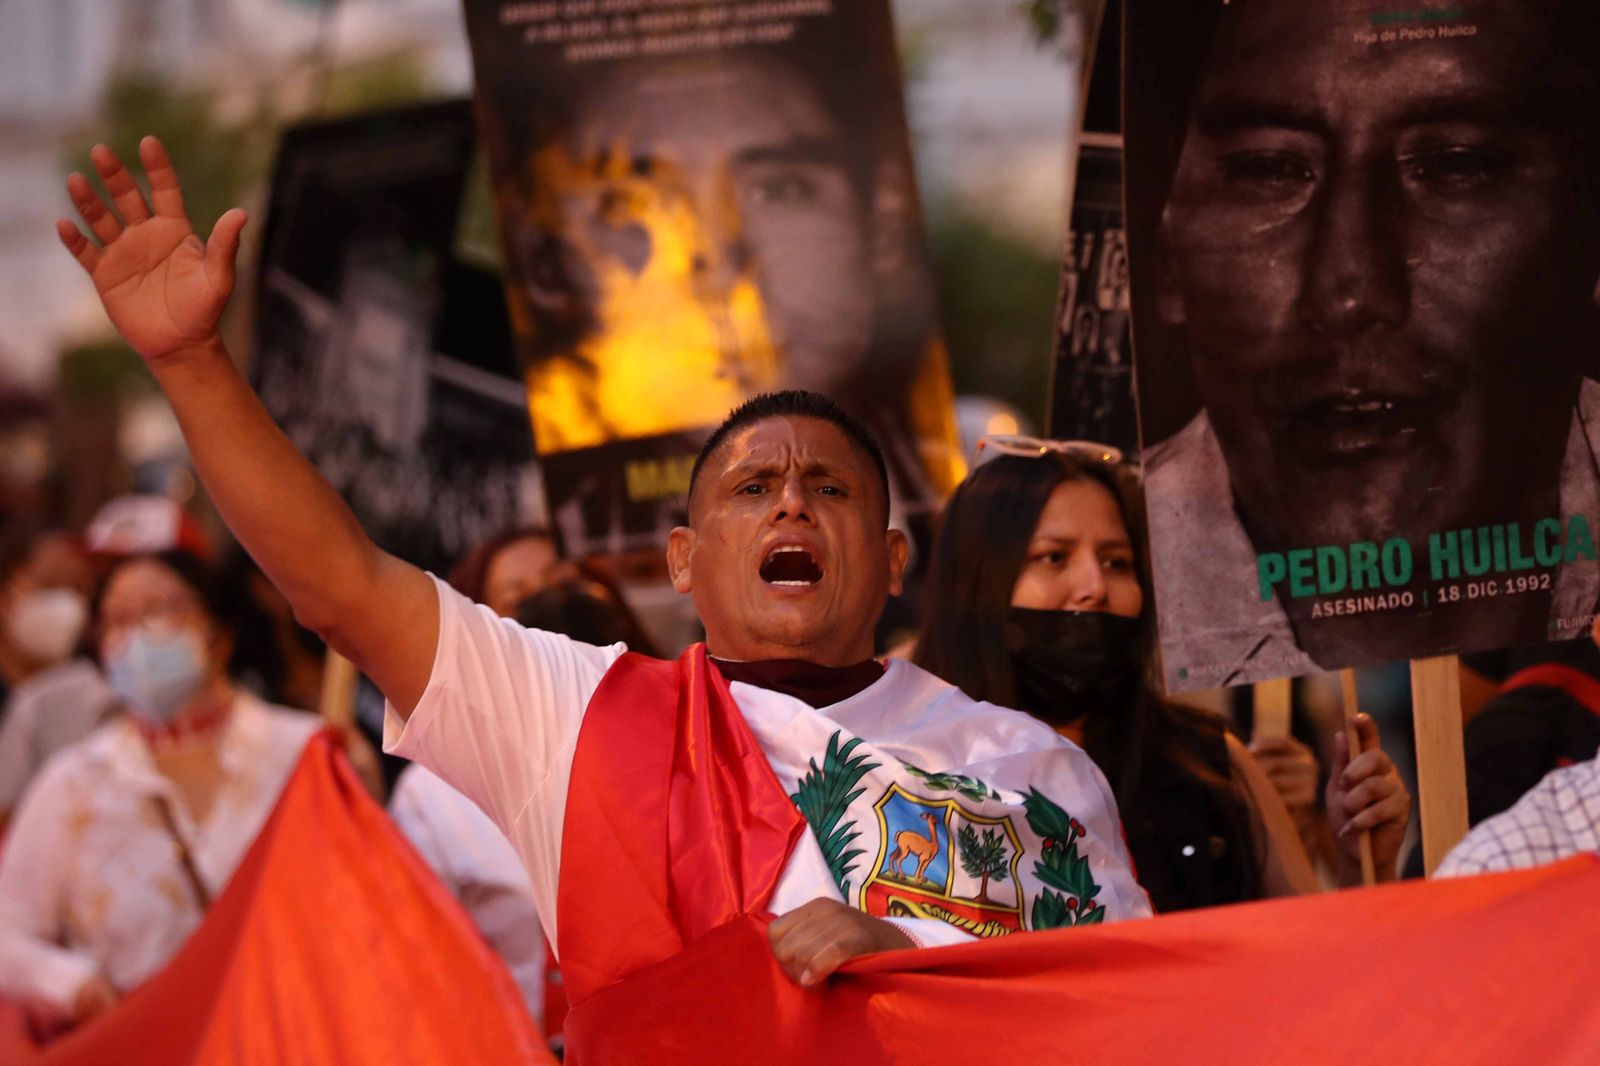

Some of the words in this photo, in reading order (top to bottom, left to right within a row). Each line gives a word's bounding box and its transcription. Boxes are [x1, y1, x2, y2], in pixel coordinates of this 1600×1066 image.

[1380, 29, 1396, 42] de
[1400, 27, 1435, 41] Pedro
[1438, 25, 1477, 38] Huilca
[1256, 536, 1413, 602] PEDRO
[1428, 513, 1597, 581] HUILCA
[1311, 591, 1414, 619] ASESINADO
